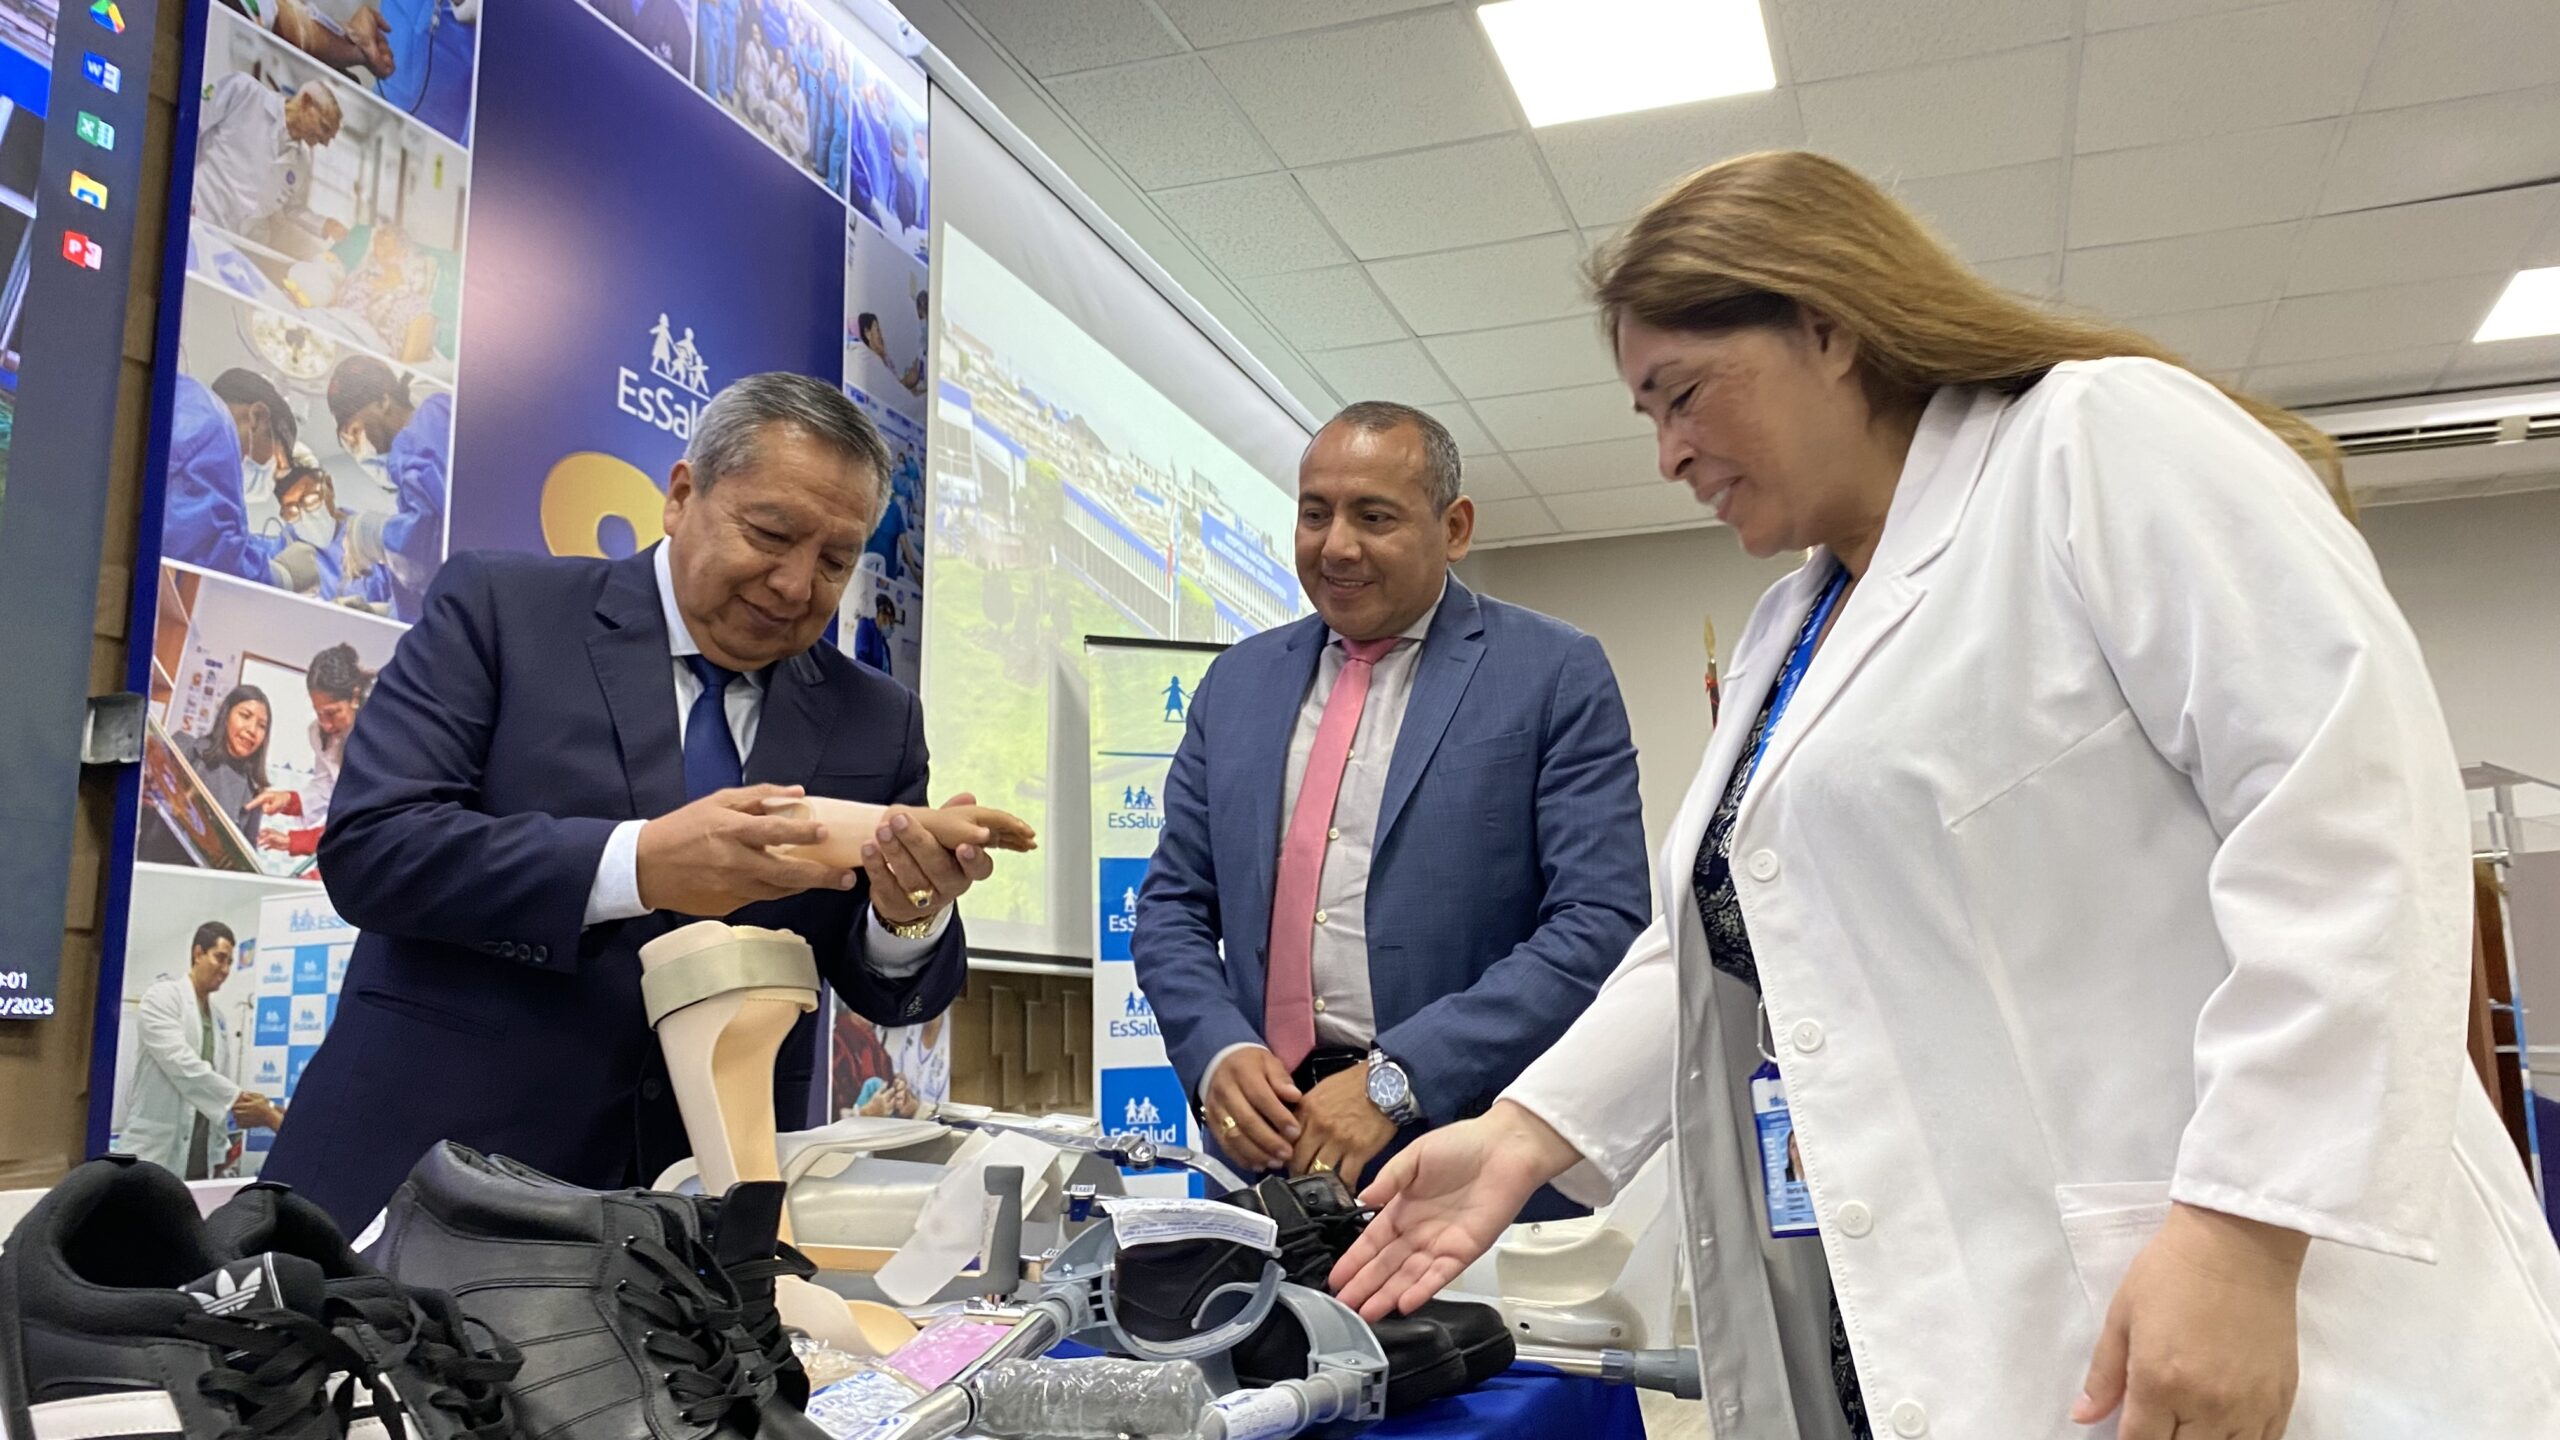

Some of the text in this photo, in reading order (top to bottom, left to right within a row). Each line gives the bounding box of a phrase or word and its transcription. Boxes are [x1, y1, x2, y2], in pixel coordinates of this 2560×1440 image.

[617, 366, 698, 441] EsSal
[1108, 914, 1137, 932] EsS
[1110, 1019, 1160, 1037] EsSalu
